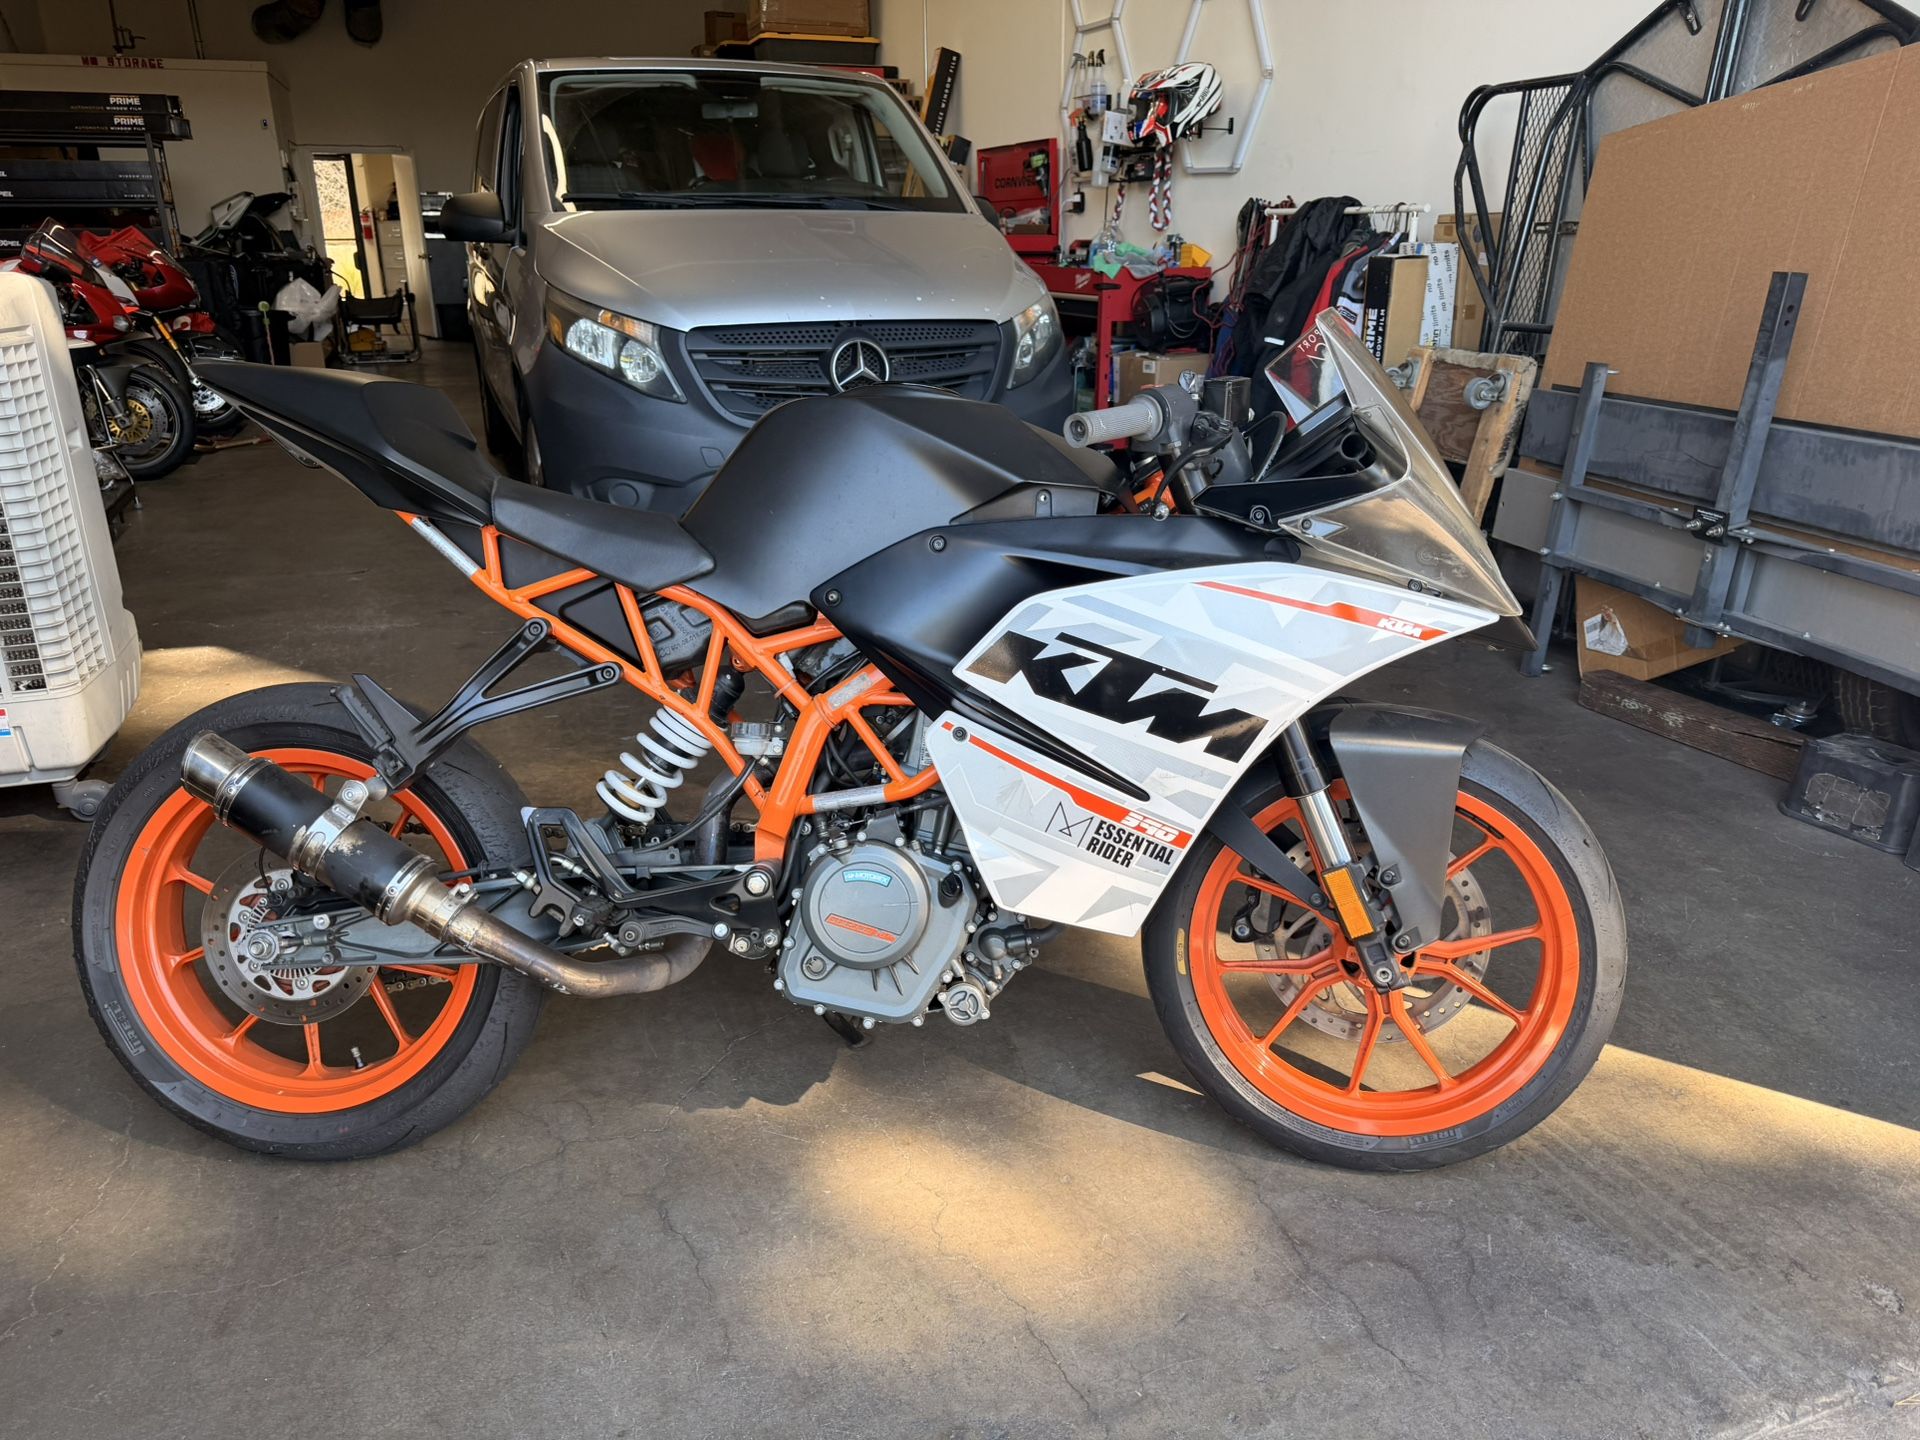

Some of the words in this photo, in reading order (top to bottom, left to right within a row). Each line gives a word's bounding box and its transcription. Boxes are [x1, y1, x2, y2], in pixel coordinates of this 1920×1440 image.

[81, 56, 98, 66] NO
[107, 57, 164, 69] STORAGE
[940, 76, 952, 109] WINDOW
[948, 55, 957, 73] FILM
[109, 97, 141, 106] PRIME
[113, 117, 145, 126] PRIME
[1437, 278, 1445, 300] limits
[1377, 618, 1423, 638] KTM
[966, 631, 1269, 764] KTM
[1120, 811, 1180, 843] 390
[1085, 836, 1135, 868] RIDER
[1094, 820, 1175, 866] ESSENTIAL
